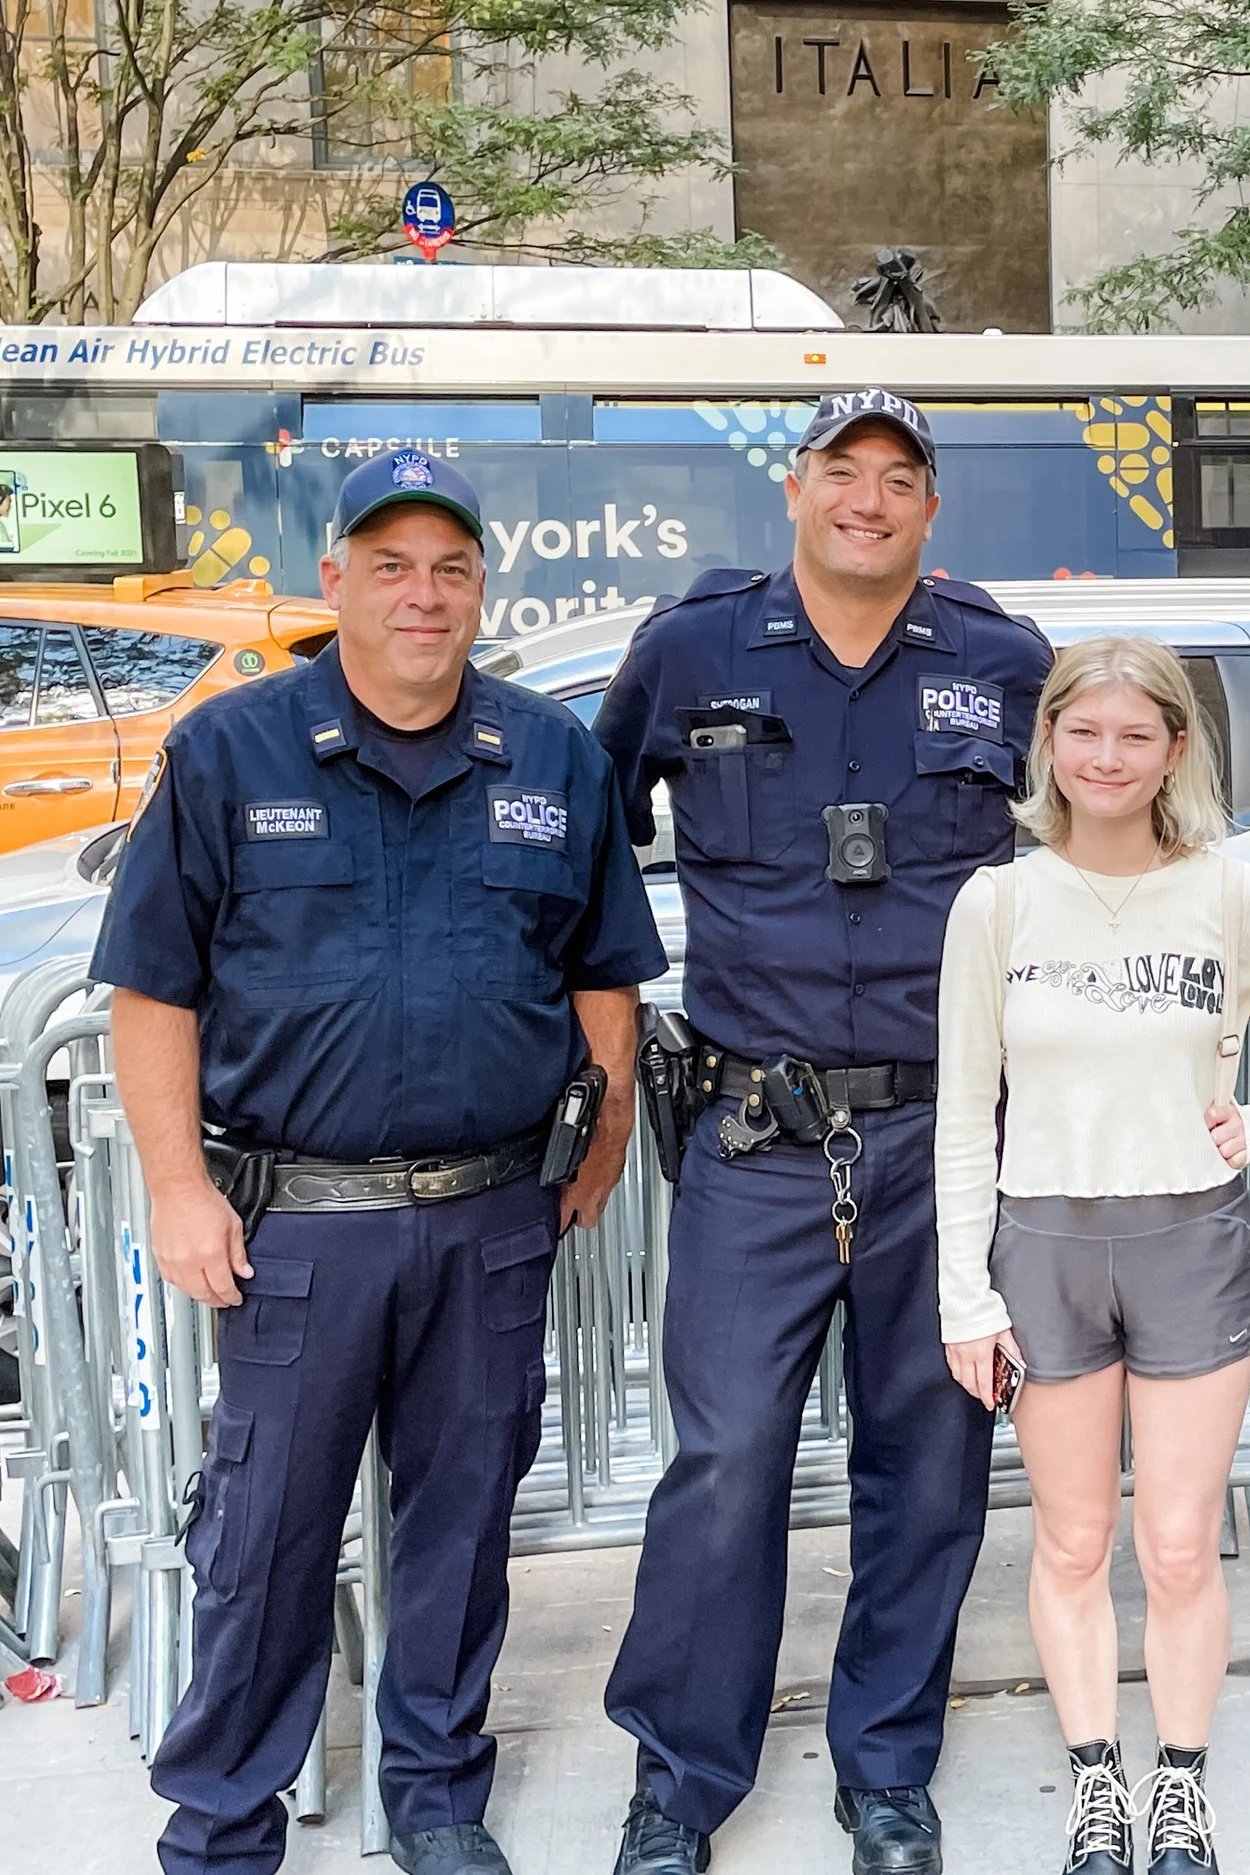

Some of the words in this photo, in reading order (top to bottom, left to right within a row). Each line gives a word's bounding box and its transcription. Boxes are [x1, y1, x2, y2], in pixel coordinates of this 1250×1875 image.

[68, 337, 116, 364] Air
[126, 338, 232, 370] Hybrid
[242, 338, 357, 366] Electric
[369, 341, 425, 367] Bus
[829, 388, 919, 431] NYPD
[394, 453, 428, 466] NYPD
[22, 493, 91, 518] Pixel
[98, 494, 117, 518] 6
[922, 688, 1001, 723] POLICE
[249, 807, 322, 822] LIEUTENANT
[256, 820, 315, 834] McKEON
[493, 799, 568, 832] POLICE
[1123, 952, 1181, 997] LOVE
